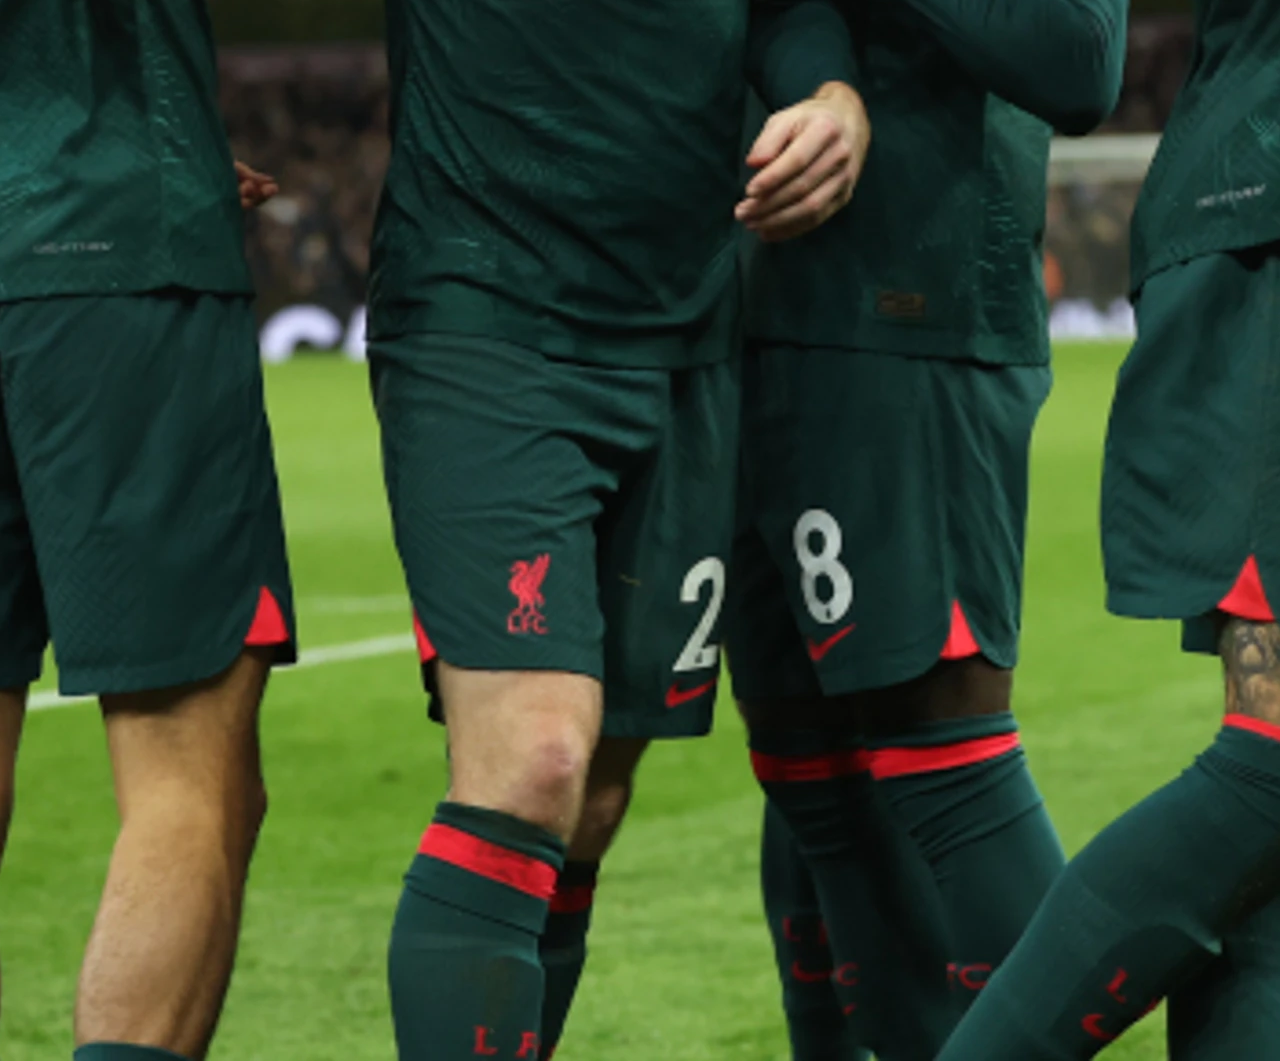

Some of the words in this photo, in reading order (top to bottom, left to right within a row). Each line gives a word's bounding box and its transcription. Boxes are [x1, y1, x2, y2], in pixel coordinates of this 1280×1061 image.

[506, 612, 550, 635] LFC
[672, 556, 725, 673] 2
[793, 507, 853, 625] 8
